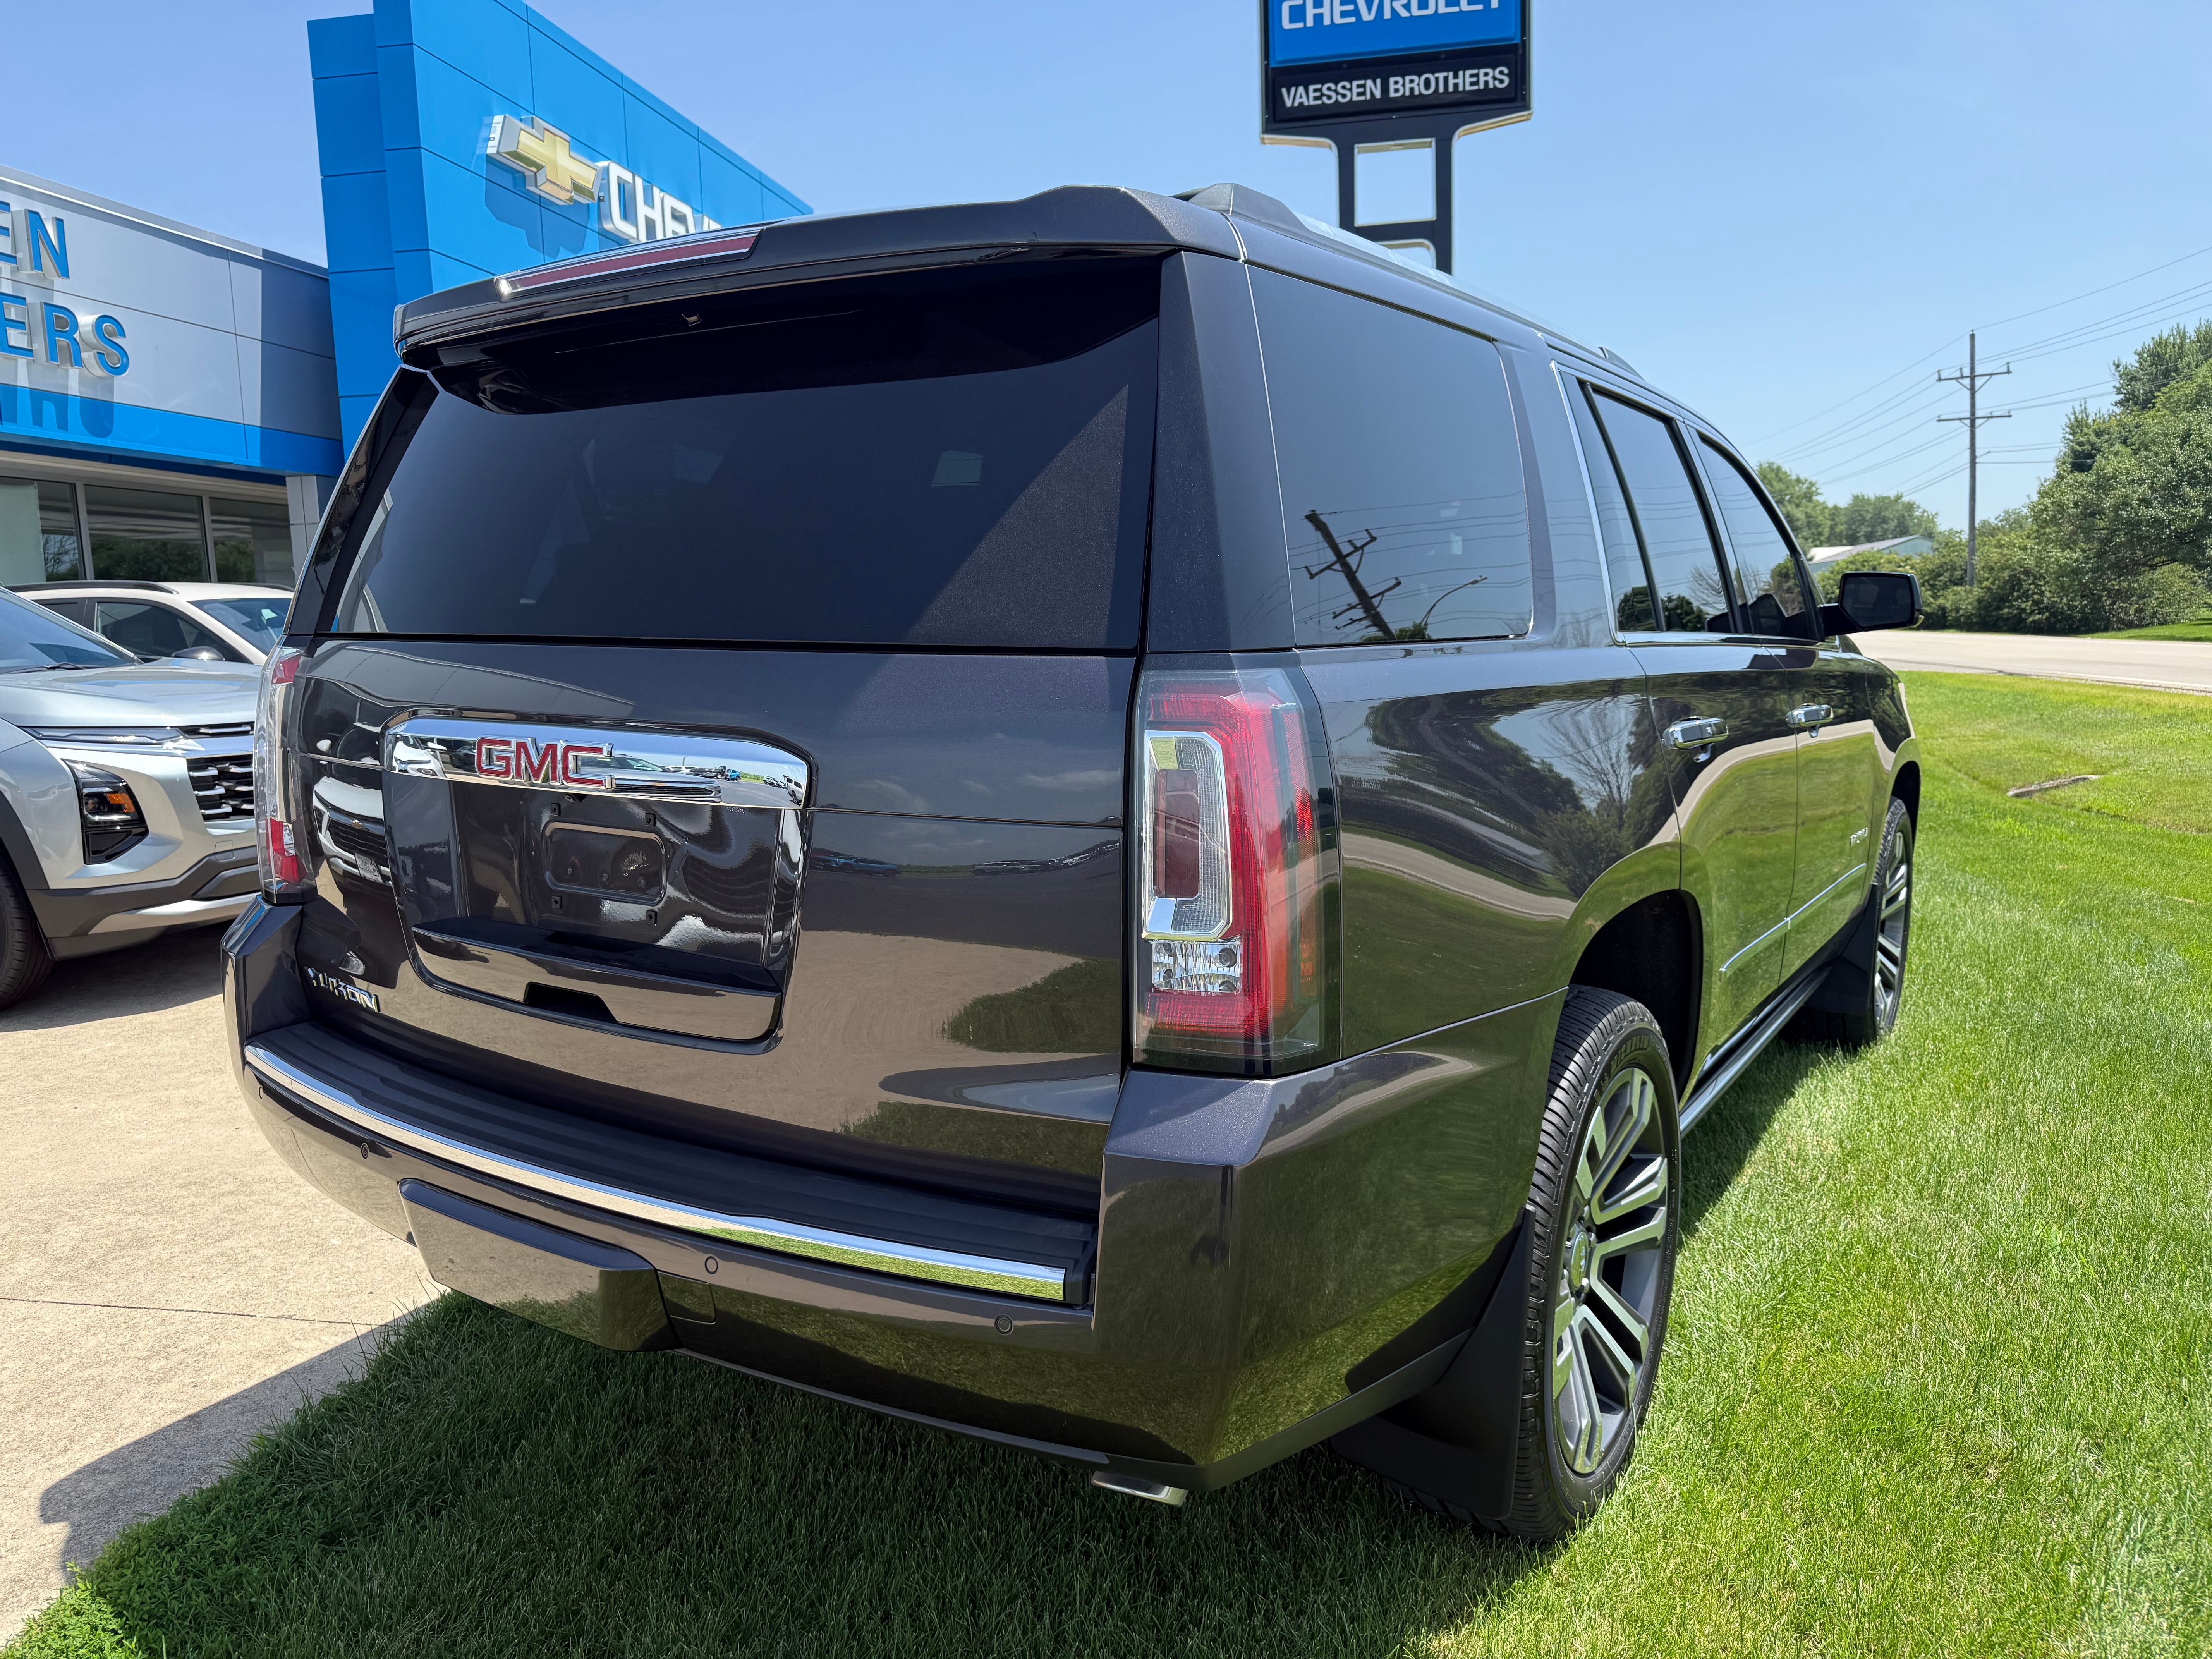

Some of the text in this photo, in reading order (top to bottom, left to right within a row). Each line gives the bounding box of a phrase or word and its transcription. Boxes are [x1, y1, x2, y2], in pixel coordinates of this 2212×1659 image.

[1281, 67, 1510, 108] VAESSEN BROTHERS
[475, 735, 616, 789] GMC
